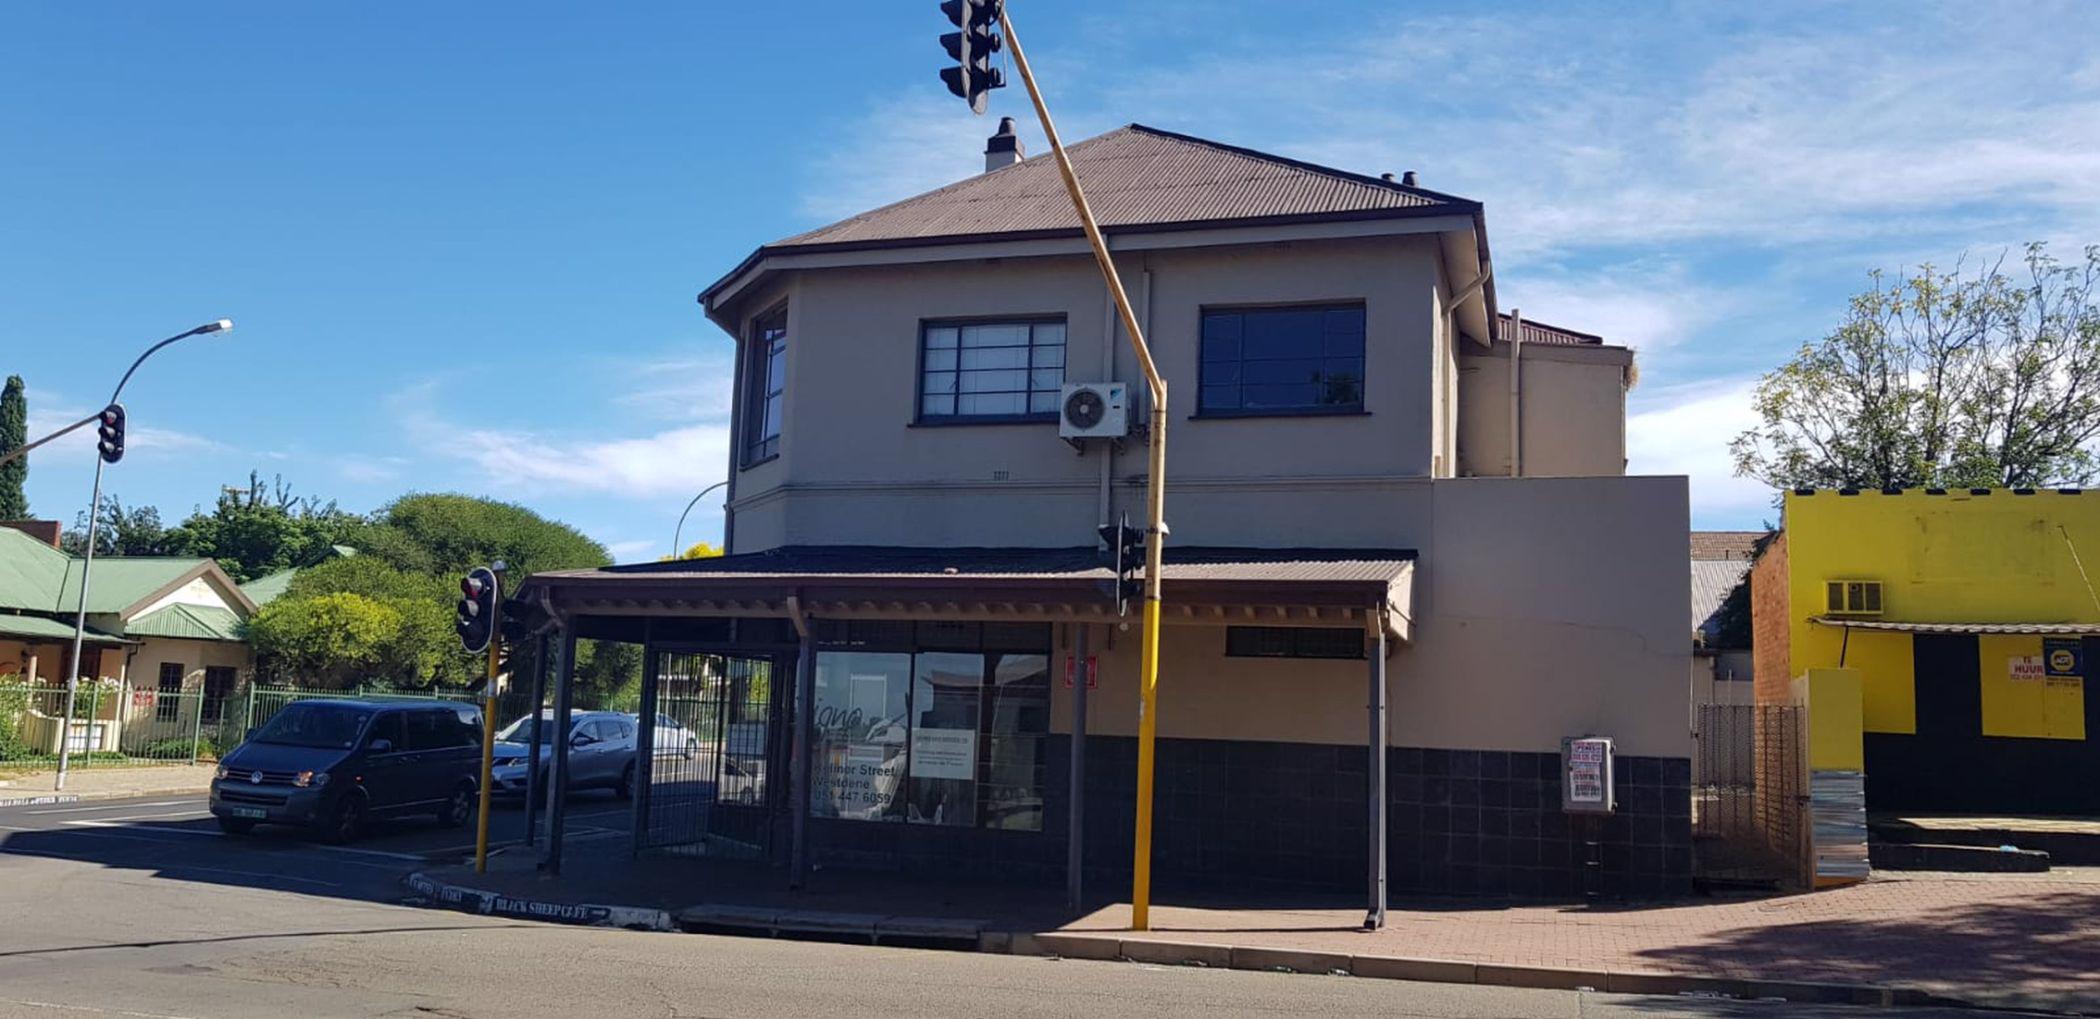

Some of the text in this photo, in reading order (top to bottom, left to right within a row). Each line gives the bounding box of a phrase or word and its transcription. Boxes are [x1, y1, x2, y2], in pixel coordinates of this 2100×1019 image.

[2014, 665, 2044, 674] HUUR
[859, 764, 895, 776] Street
[838, 791, 859, 801] 447
[863, 792, 891, 804] 6059
[496, 898, 527, 913] BLACK
[529, 902, 560, 916] SHEEP
